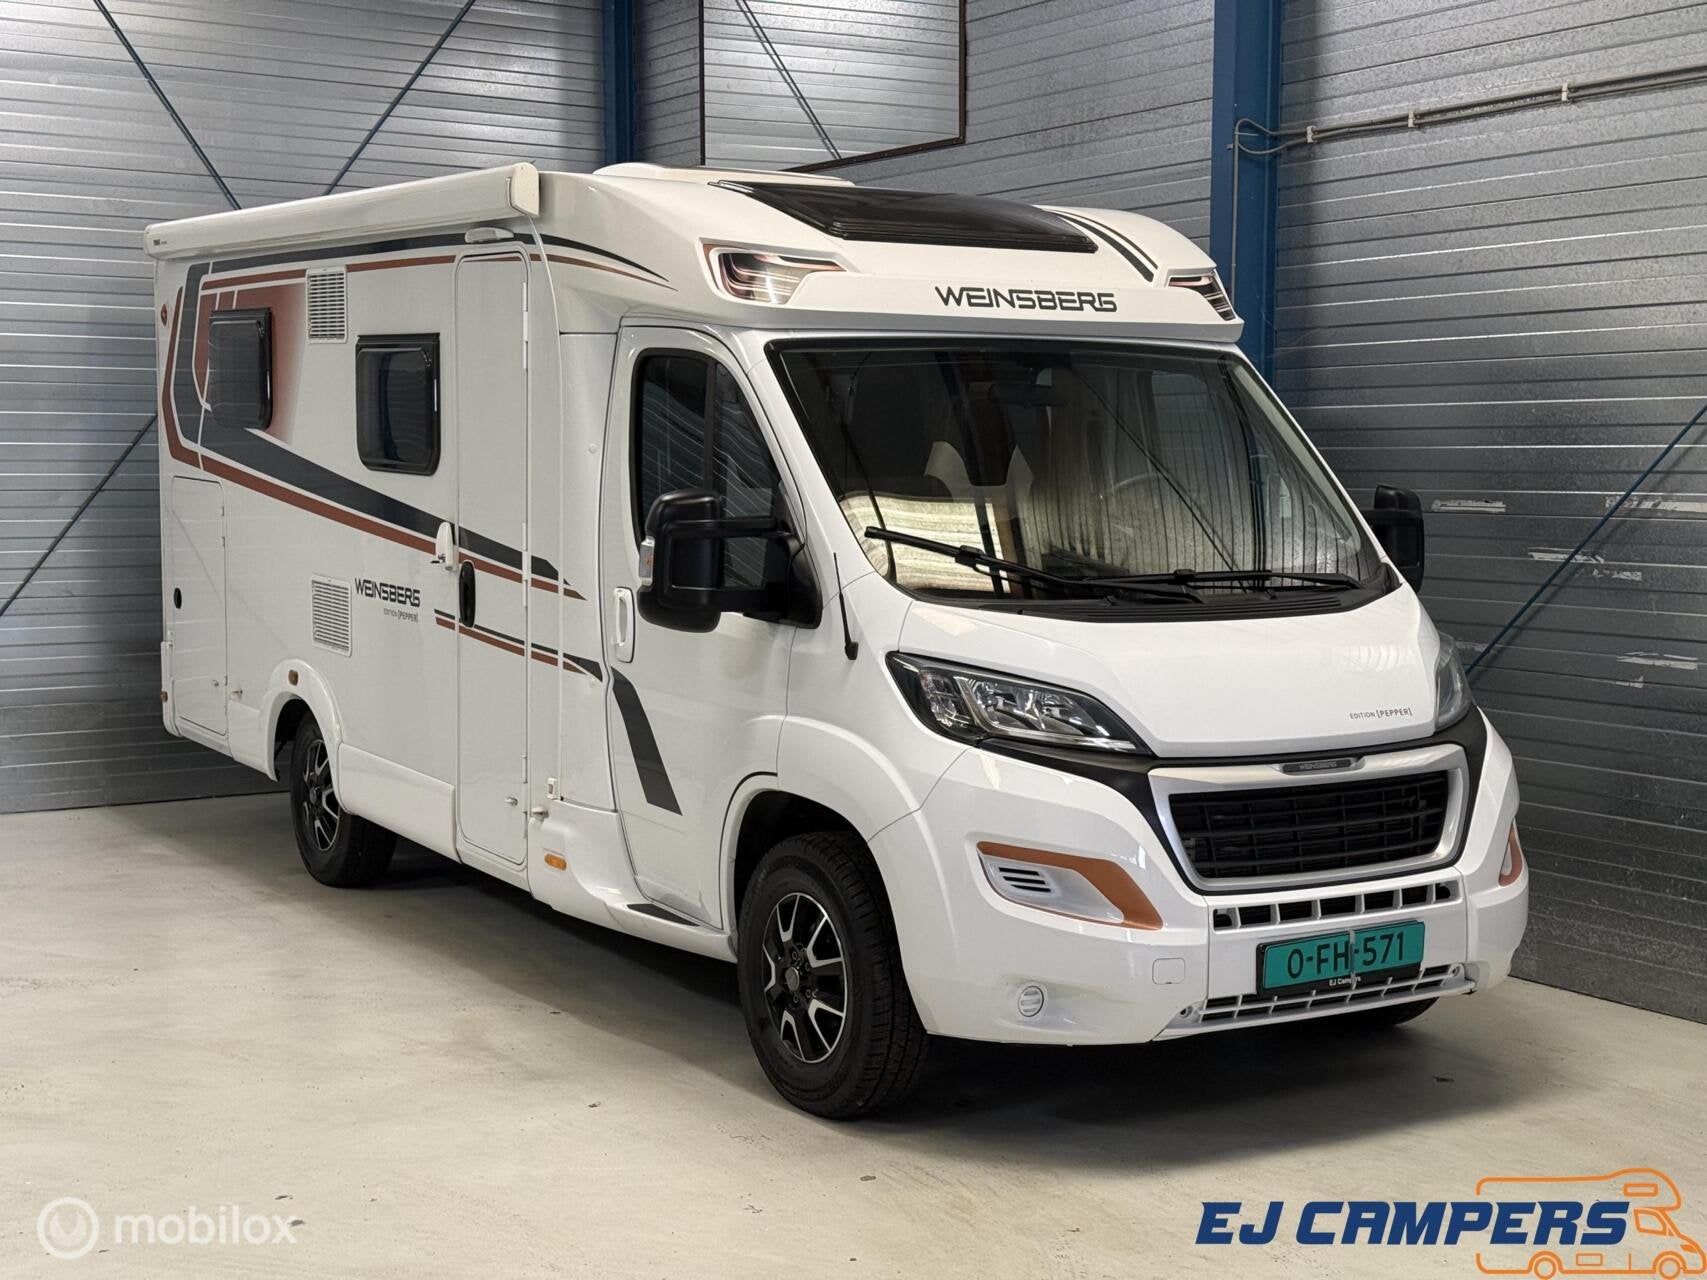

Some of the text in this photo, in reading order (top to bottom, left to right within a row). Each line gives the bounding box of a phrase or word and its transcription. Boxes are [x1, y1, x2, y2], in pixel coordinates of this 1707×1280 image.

[934, 286, 1118, 312] WEINSBERG
[354, 577, 421, 608] WEINSBERG
[1349, 711, 1375, 719] EDITION
[1337, 976, 1361, 985] Camprs
